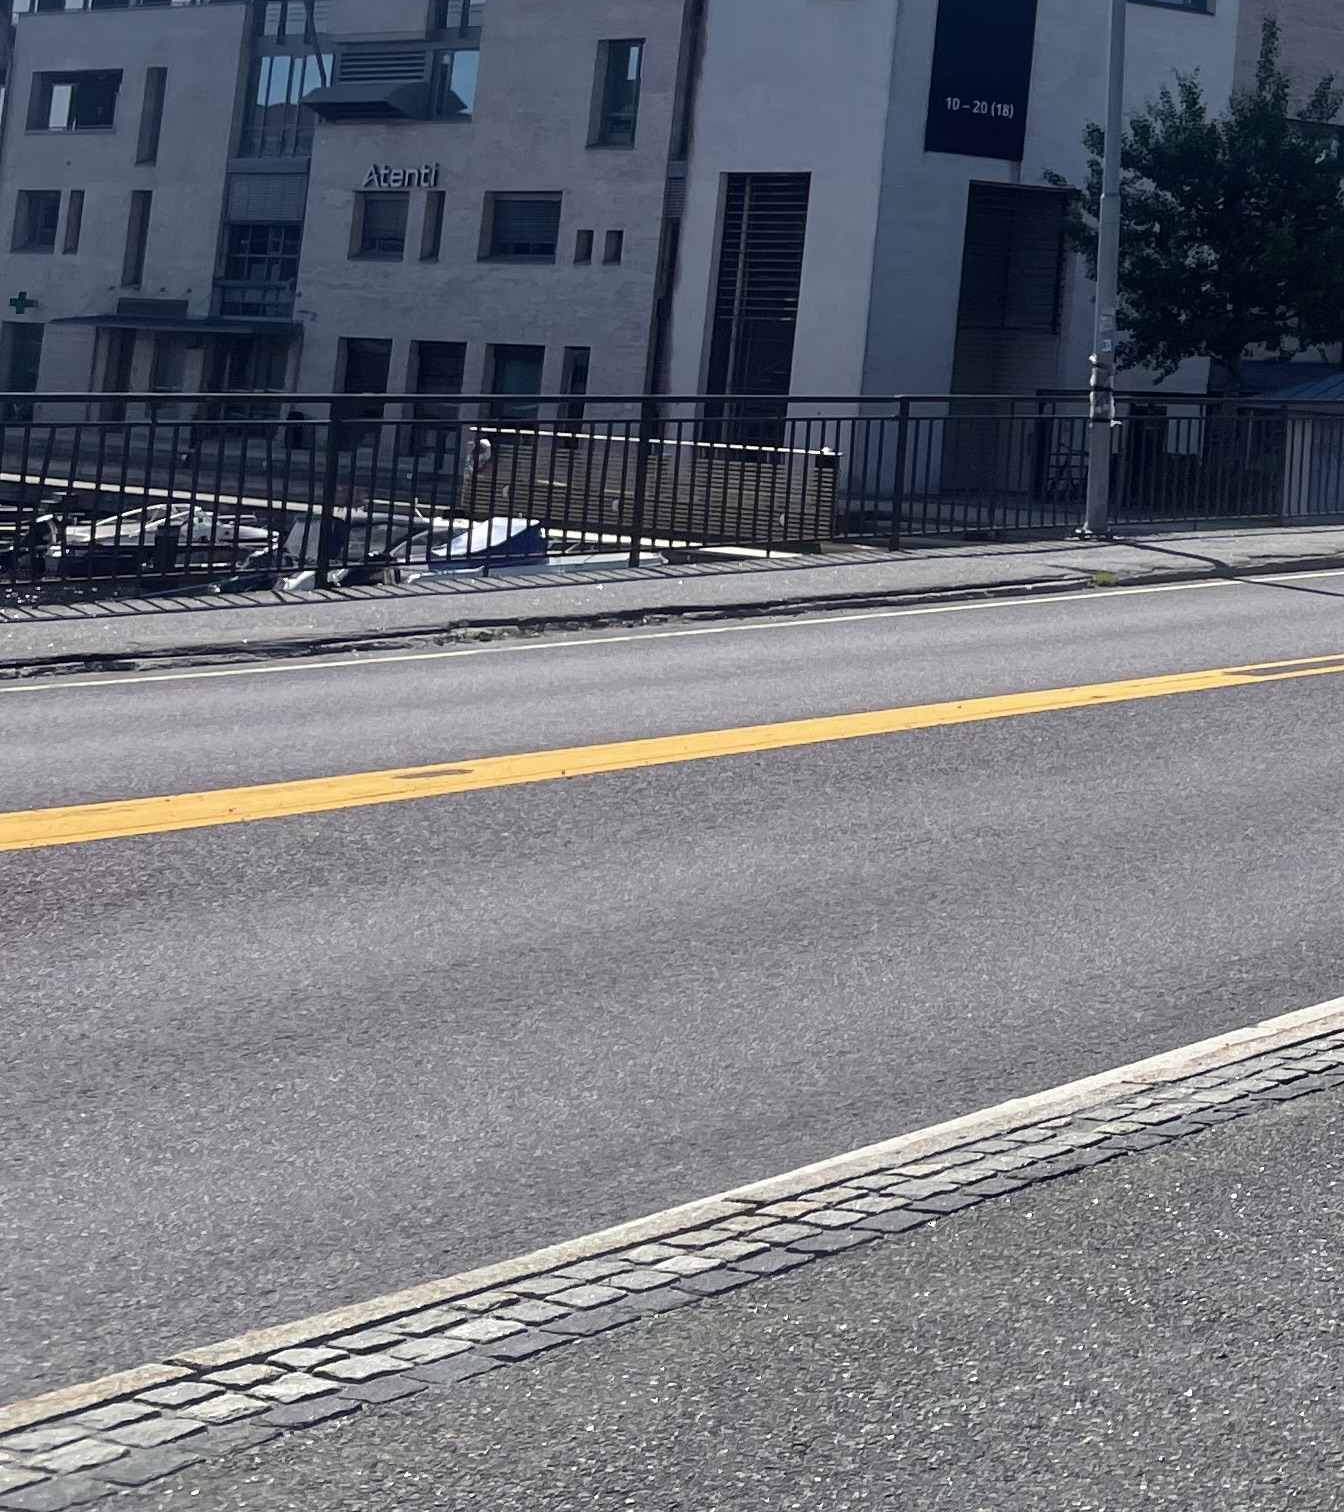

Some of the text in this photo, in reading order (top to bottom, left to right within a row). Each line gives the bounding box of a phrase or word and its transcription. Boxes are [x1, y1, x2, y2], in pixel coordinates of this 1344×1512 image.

[945, 96, 961, 111] 10
[972, 100, 988, 114] 20
[360, 162, 440, 188] Atenti
